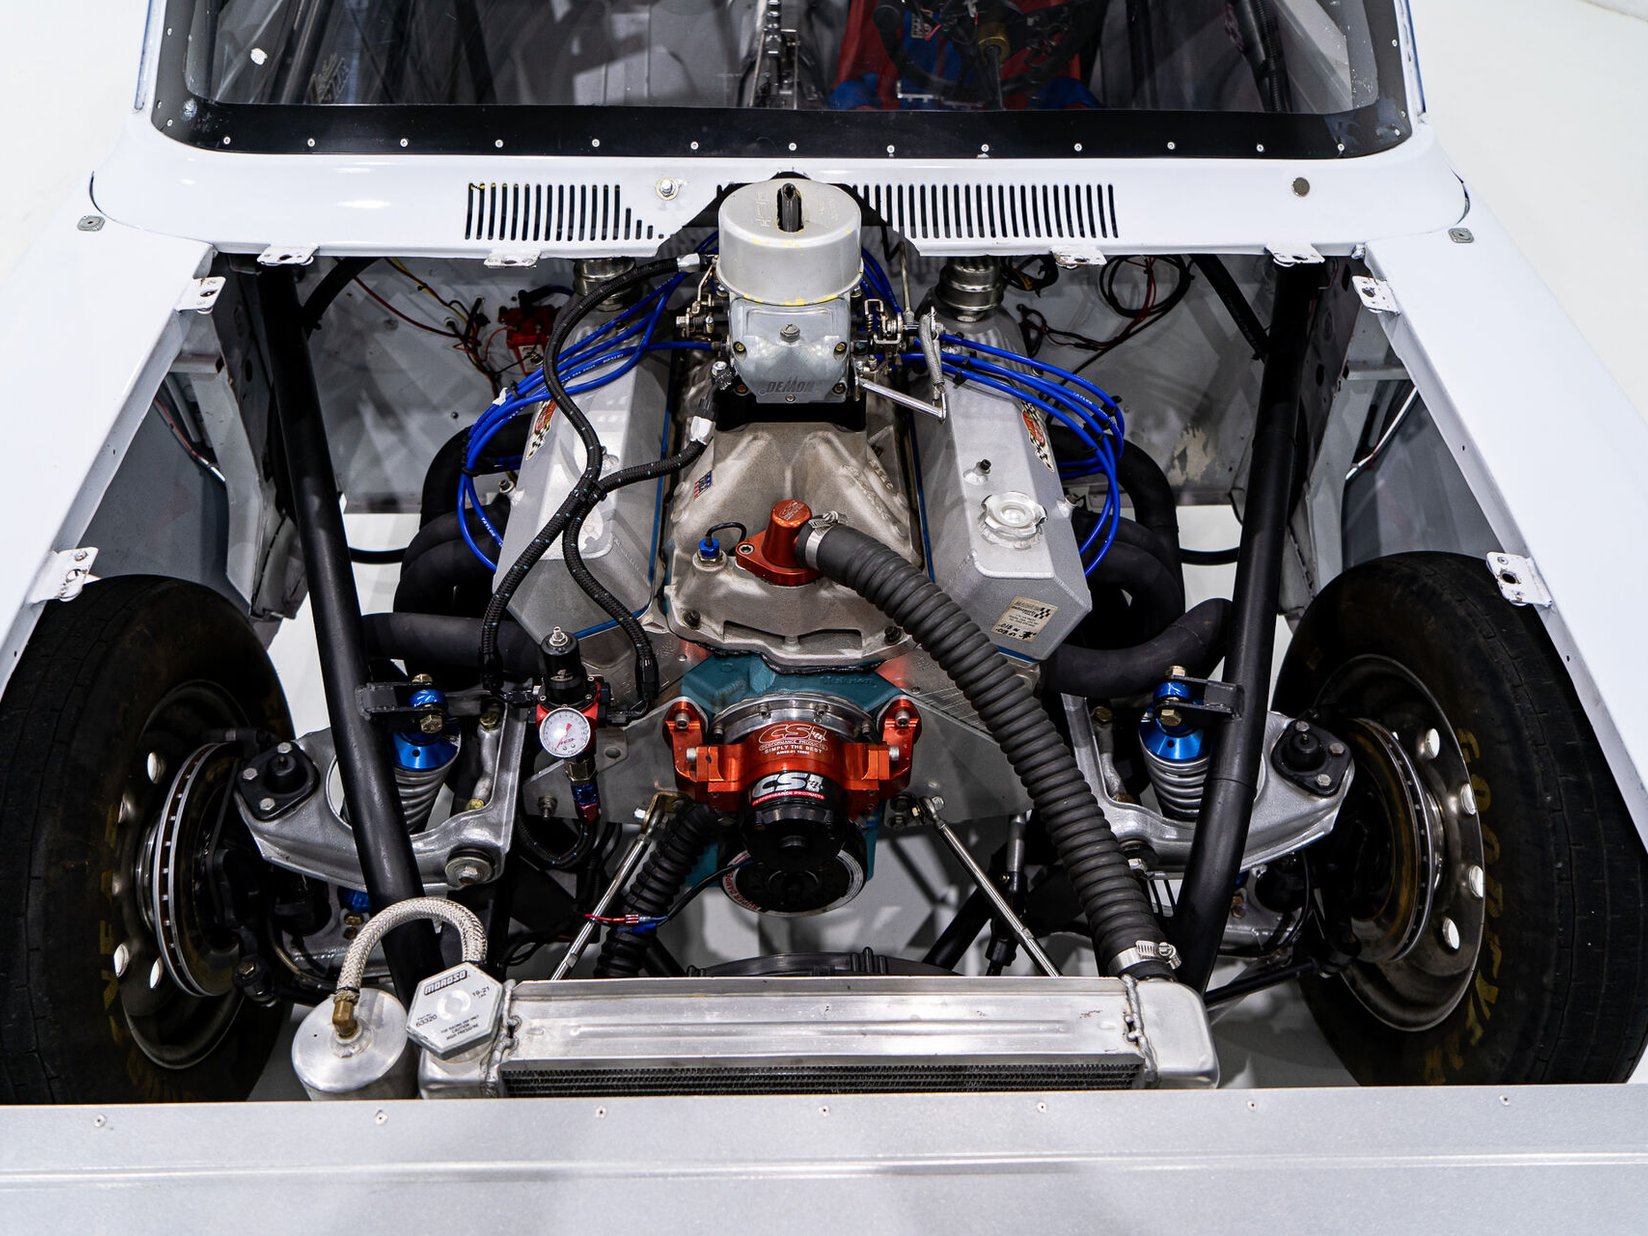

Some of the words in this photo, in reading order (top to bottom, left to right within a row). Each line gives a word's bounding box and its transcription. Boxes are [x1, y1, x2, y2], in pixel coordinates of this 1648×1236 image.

[767, 376, 816, 393] DEMON
[480, 517, 497, 538] TAYLOR
[759, 723, 828, 744] CSI
[764, 745, 788, 754] SIMPLY
[805, 745, 823, 754] BEST
[752, 772, 824, 798] CSI
[793, 790, 825, 800] PRODUCTS
[736, 891, 761, 911] SUPER
[424, 970, 468, 995] MOROSO
